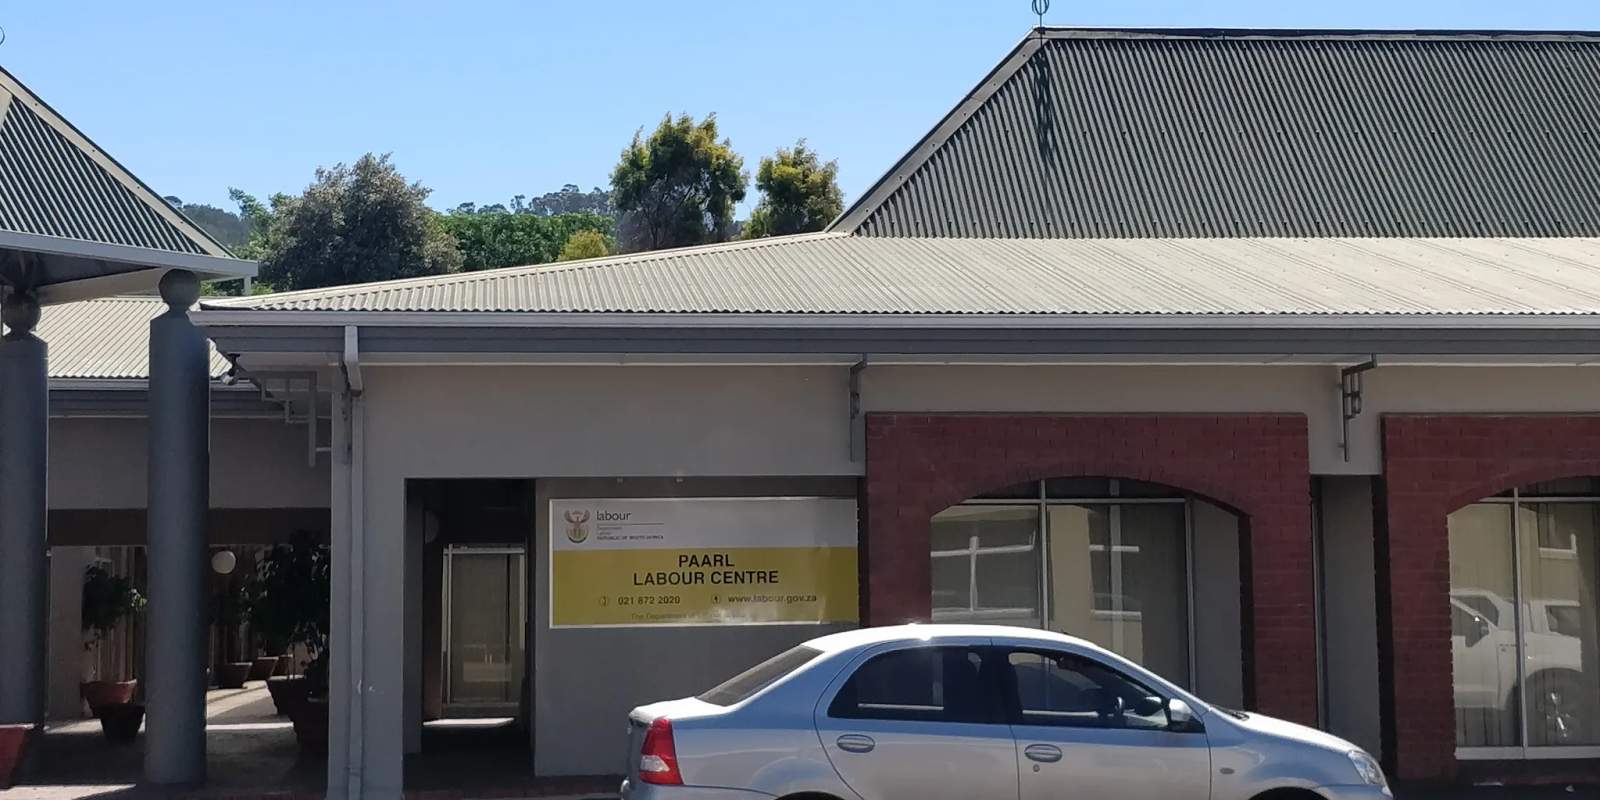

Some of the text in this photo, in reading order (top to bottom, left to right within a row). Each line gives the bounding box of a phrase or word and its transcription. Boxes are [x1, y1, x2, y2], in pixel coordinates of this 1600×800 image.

[596, 510, 632, 521] labour
[678, 554, 735, 568] PAARL
[633, 570, 780, 586] LABOUR CENTRE
[617, 595, 681, 605] 021 872 2020
[727, 594, 818, 604] www.labour.gov.za
